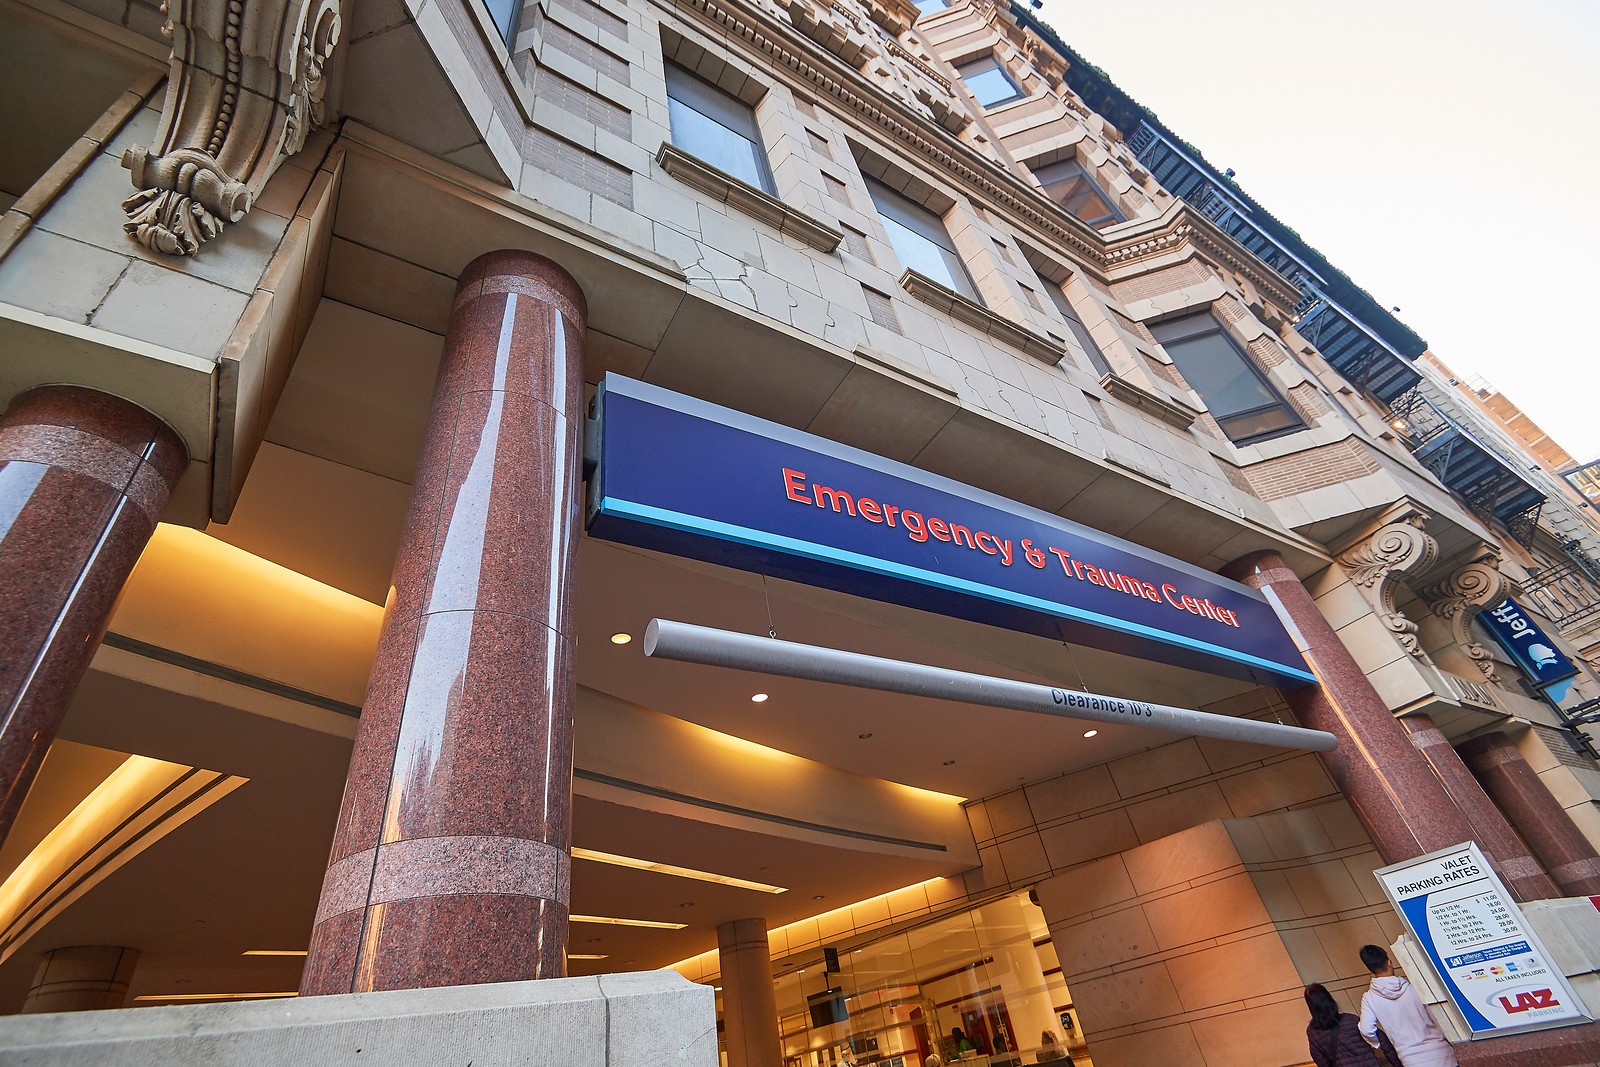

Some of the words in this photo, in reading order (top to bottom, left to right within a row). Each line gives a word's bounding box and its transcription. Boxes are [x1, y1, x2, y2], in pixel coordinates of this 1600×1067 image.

[782, 467, 1012, 566] Emergency
[1020, 538, 1046, 569] &
[1048, 546, 1162, 604] Trauma
[1161, 583, 1240, 628] Center
[1051, 688, 1125, 714] Clearance
[1440, 855, 1472, 870] VALET
[1397, 875, 1443, 895] PARKING
[1443, 865, 1480, 882] RATES
[1482, 894, 1497, 902] 11.00
[1504, 973, 1521, 981] TAXES
[1520, 969, 1547, 978] INCLUDED
[1498, 988, 1560, 1014] LAZ
[1526, 1007, 1565, 1018] PARKING
